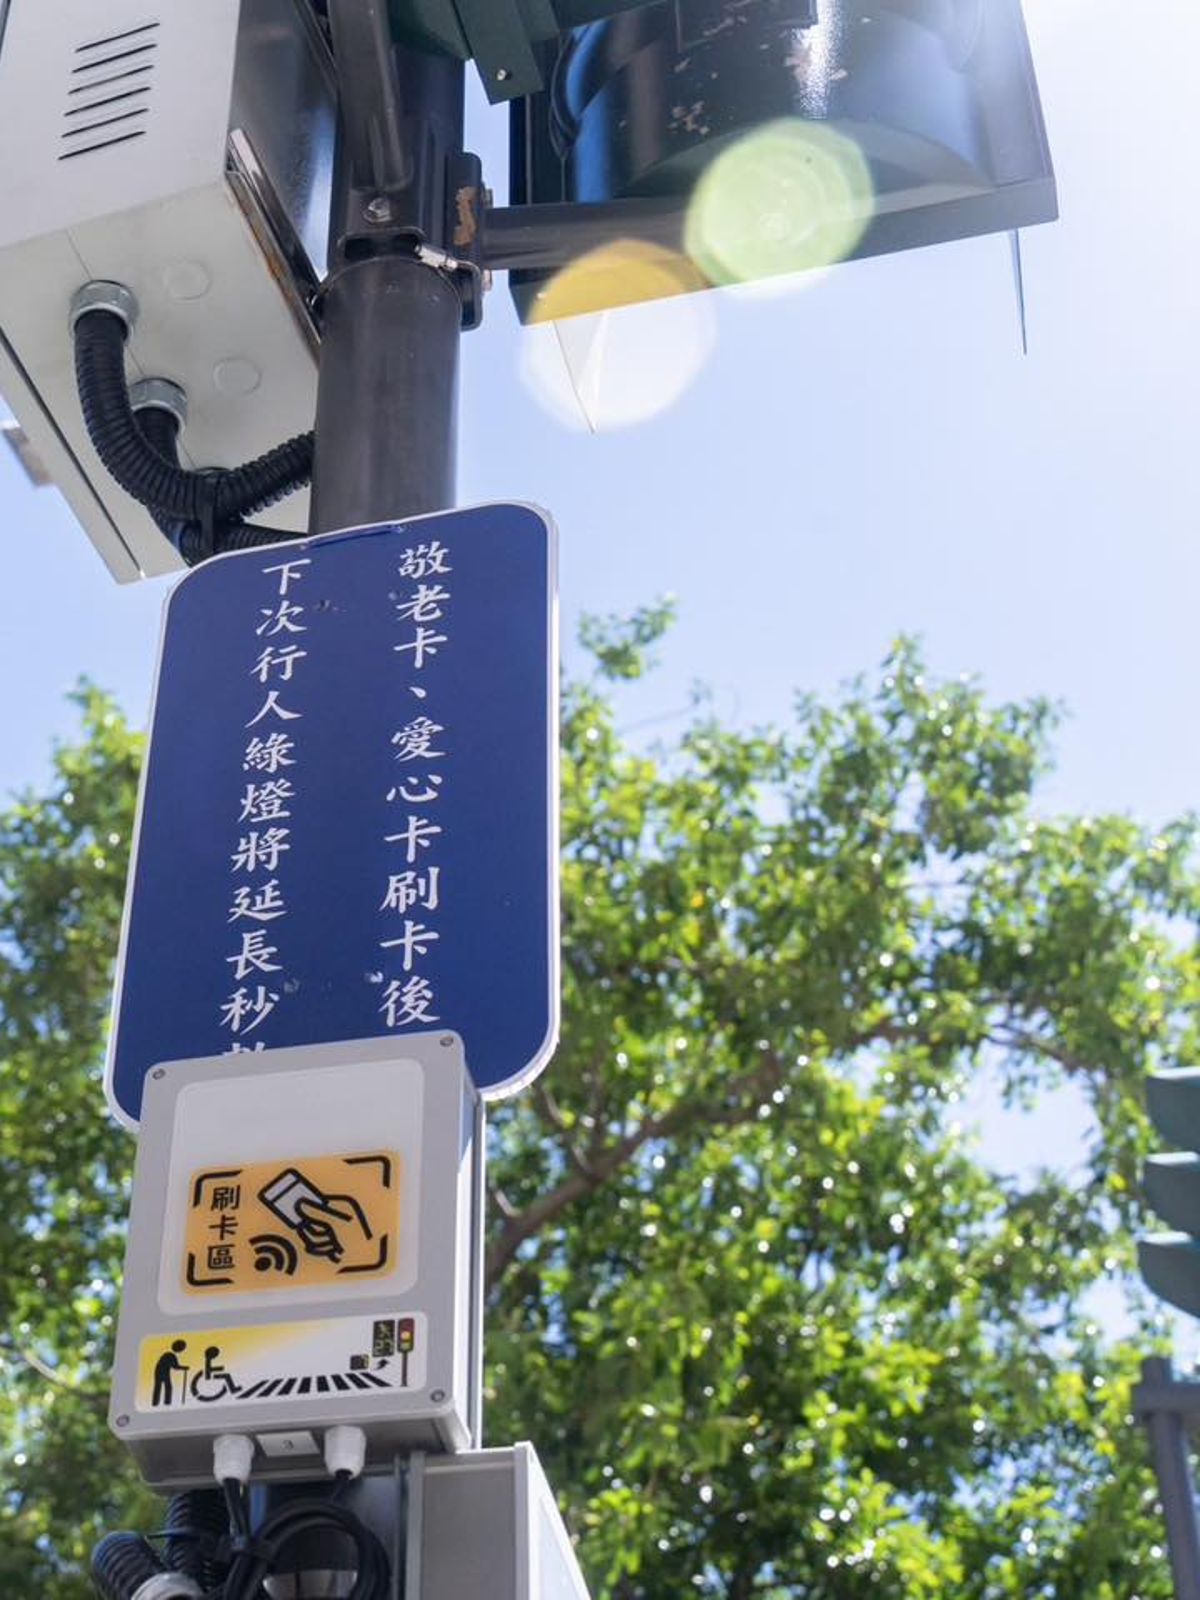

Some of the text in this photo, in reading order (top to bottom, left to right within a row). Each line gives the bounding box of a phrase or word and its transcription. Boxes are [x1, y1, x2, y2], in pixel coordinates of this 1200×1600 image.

[219, 558, 311, 1055] 下次行人綠燈將延長秒
[378, 541, 453, 1028] 敬老卡、愛心卡刷卡後
[208, 1184, 241, 1270] 刷卡區
